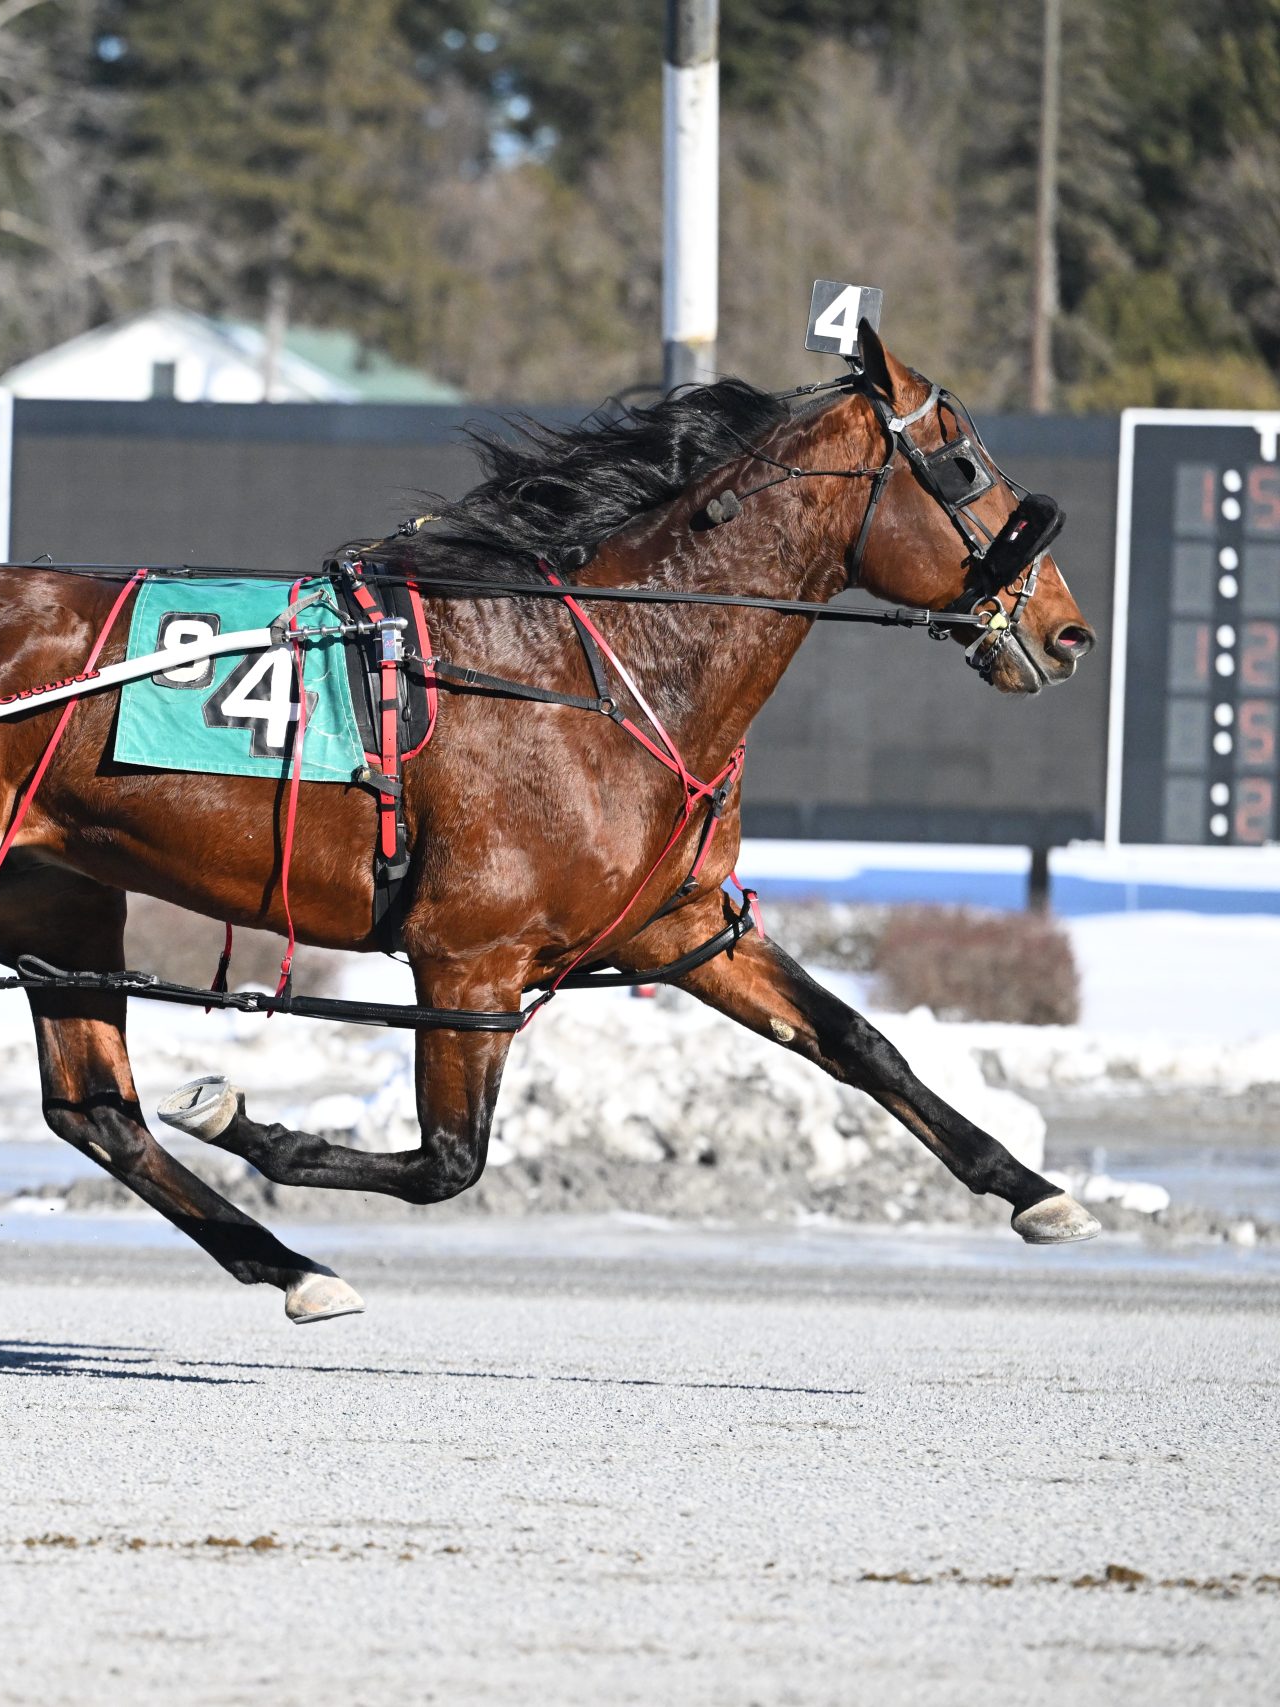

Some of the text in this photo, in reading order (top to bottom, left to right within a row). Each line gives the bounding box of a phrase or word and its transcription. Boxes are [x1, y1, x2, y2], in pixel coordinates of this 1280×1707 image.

[814, 285, 862, 355] 4
[163, 619, 214, 682] 8
[221, 646, 300, 748] 4
